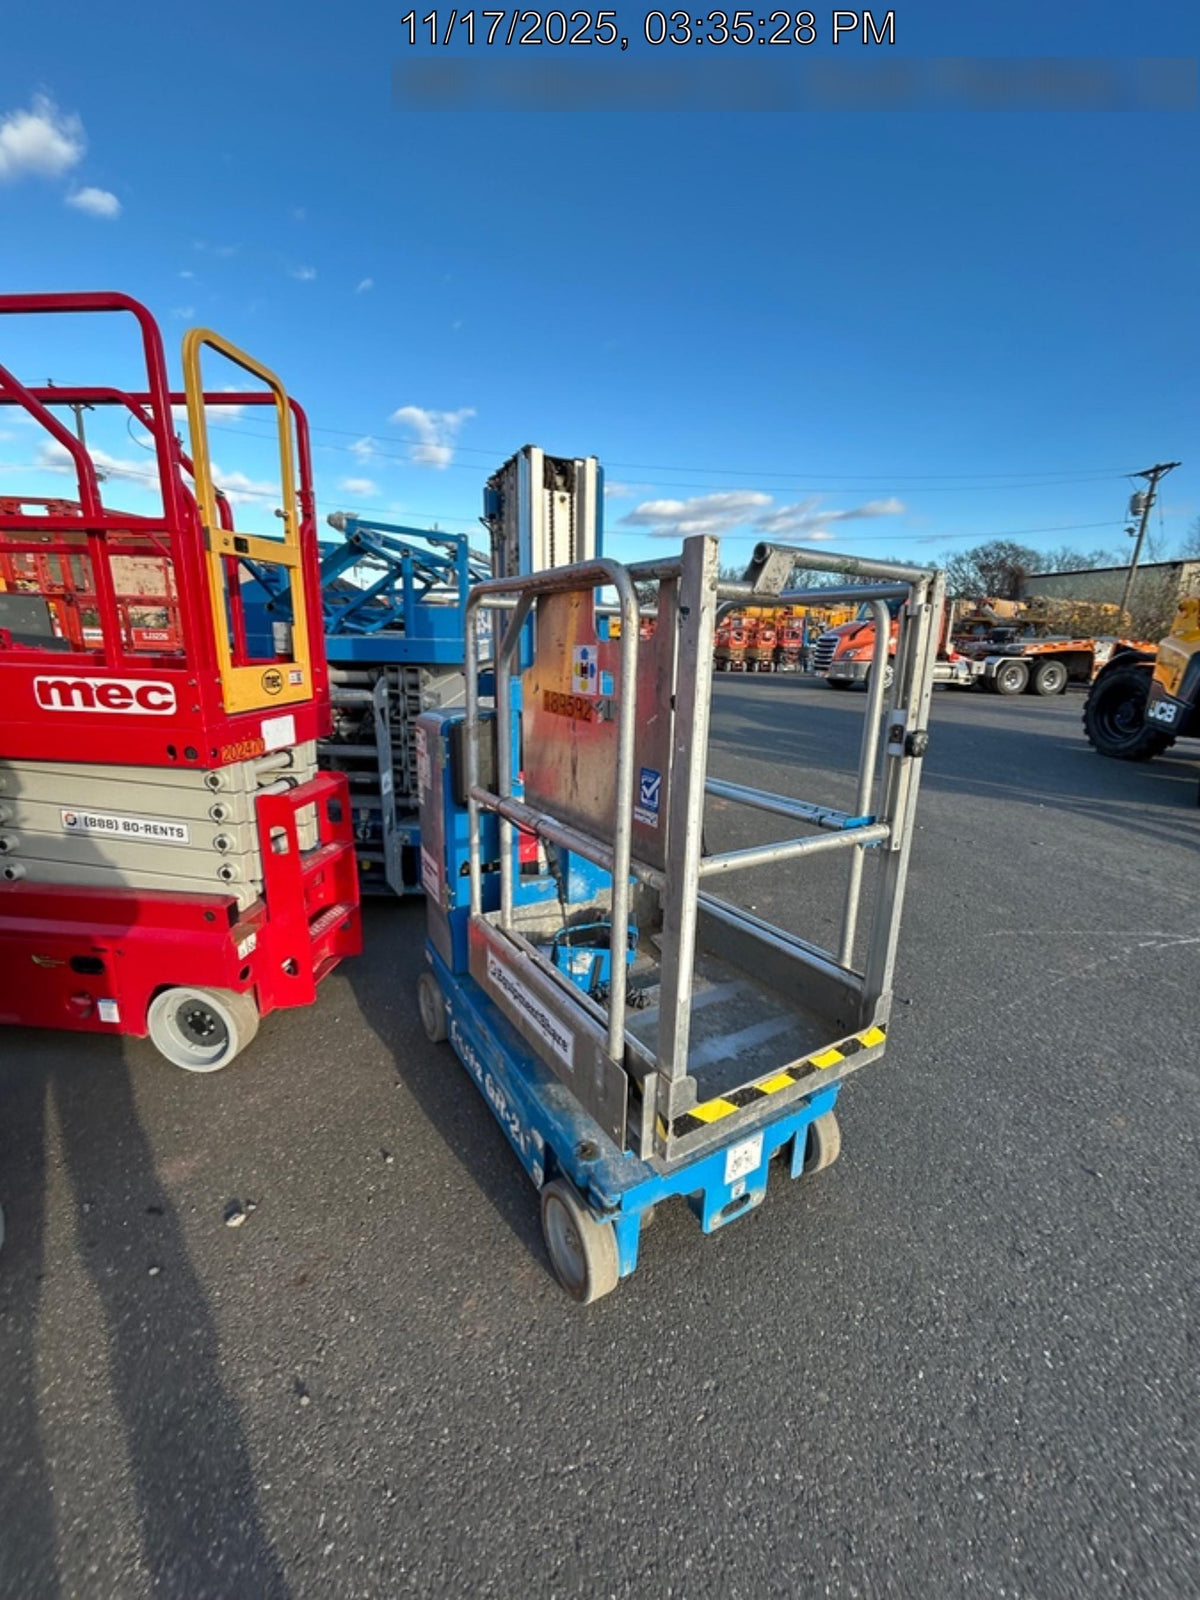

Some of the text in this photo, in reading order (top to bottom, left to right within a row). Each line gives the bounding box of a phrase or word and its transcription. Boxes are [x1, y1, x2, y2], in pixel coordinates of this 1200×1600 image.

[37, 680, 174, 711] mec
[1148, 700, 1177, 722] JCB
[84, 816, 184, 838] (888) 80-RENTS
